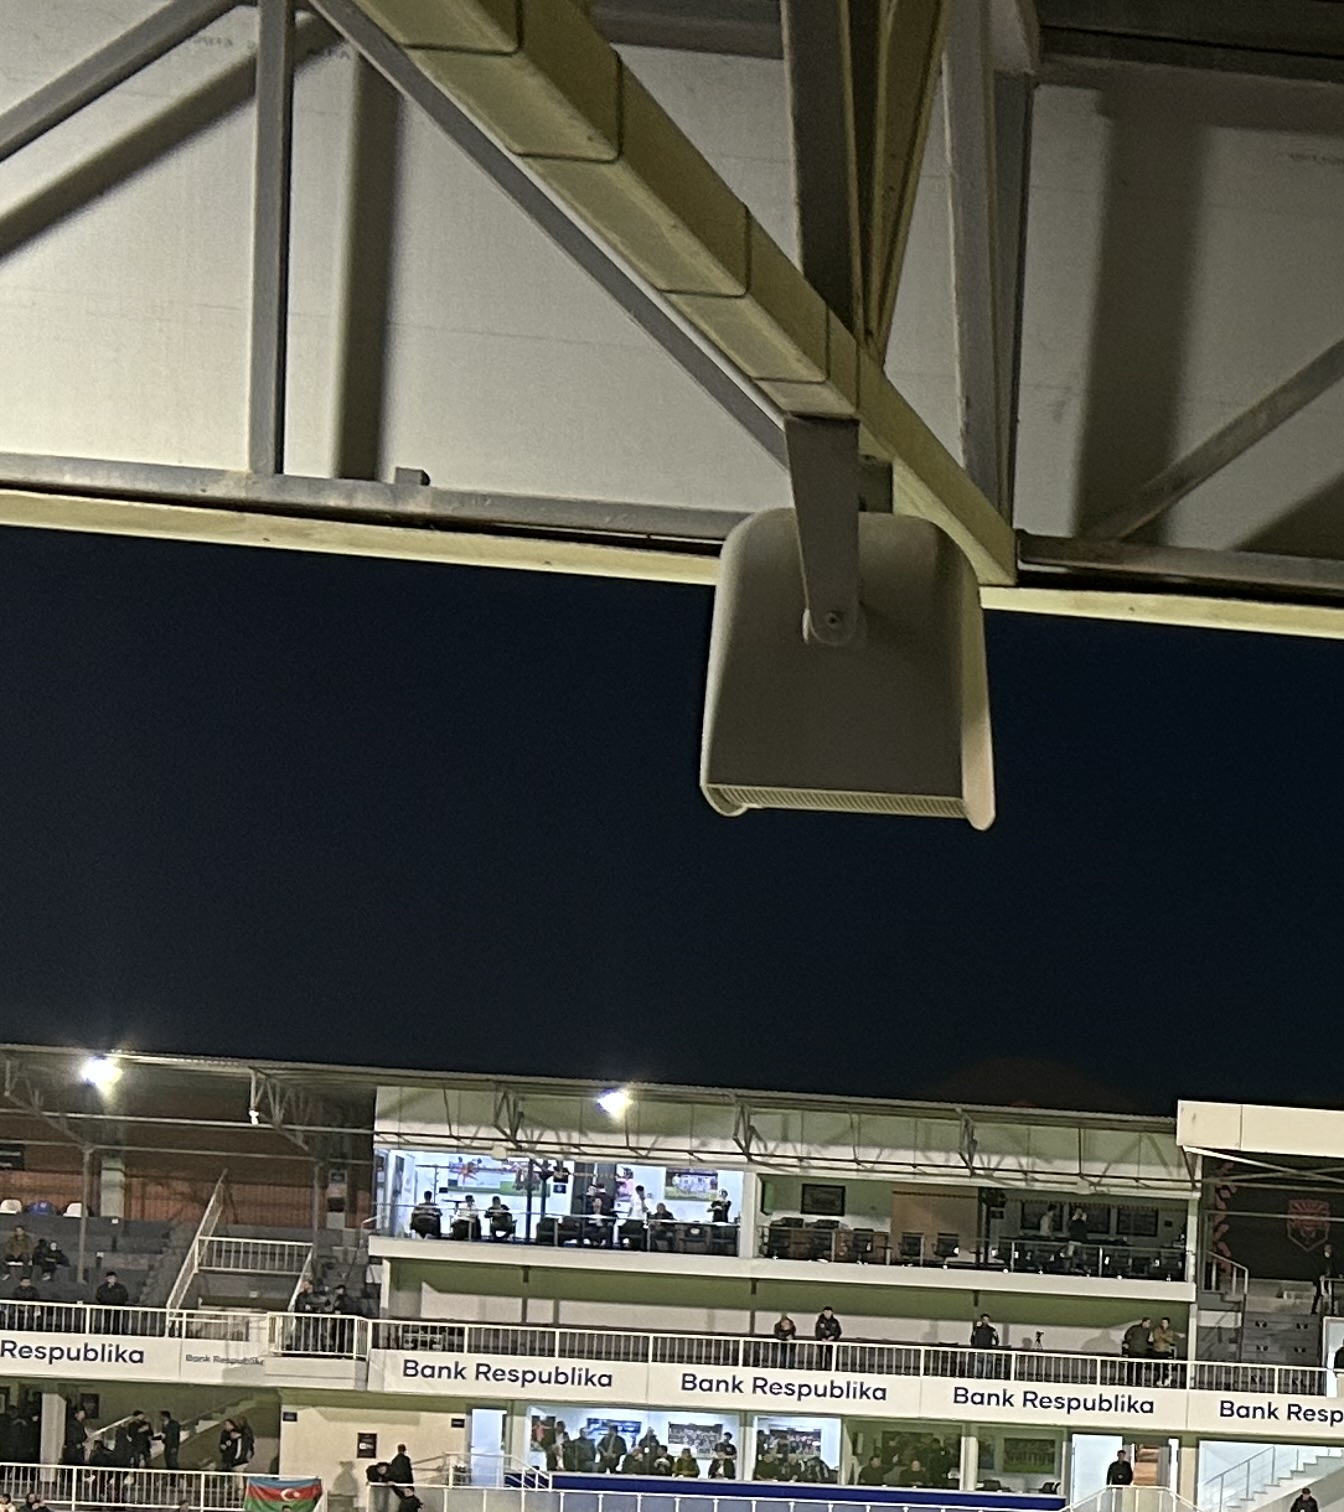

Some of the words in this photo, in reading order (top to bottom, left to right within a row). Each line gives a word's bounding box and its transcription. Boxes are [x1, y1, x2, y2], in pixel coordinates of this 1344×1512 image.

[0, 1340, 145, 1366] Respublika
[403, 1359, 467, 1381] Bank
[475, 1363, 613, 1389] Respublika
[682, 1373, 745, 1394] Bank
[752, 1377, 887, 1402] Respublika
[953, 1387, 1015, 1408] Bank
[1023, 1391, 1154, 1415] Respublika
[1220, 1400, 1280, 1421] Bank
